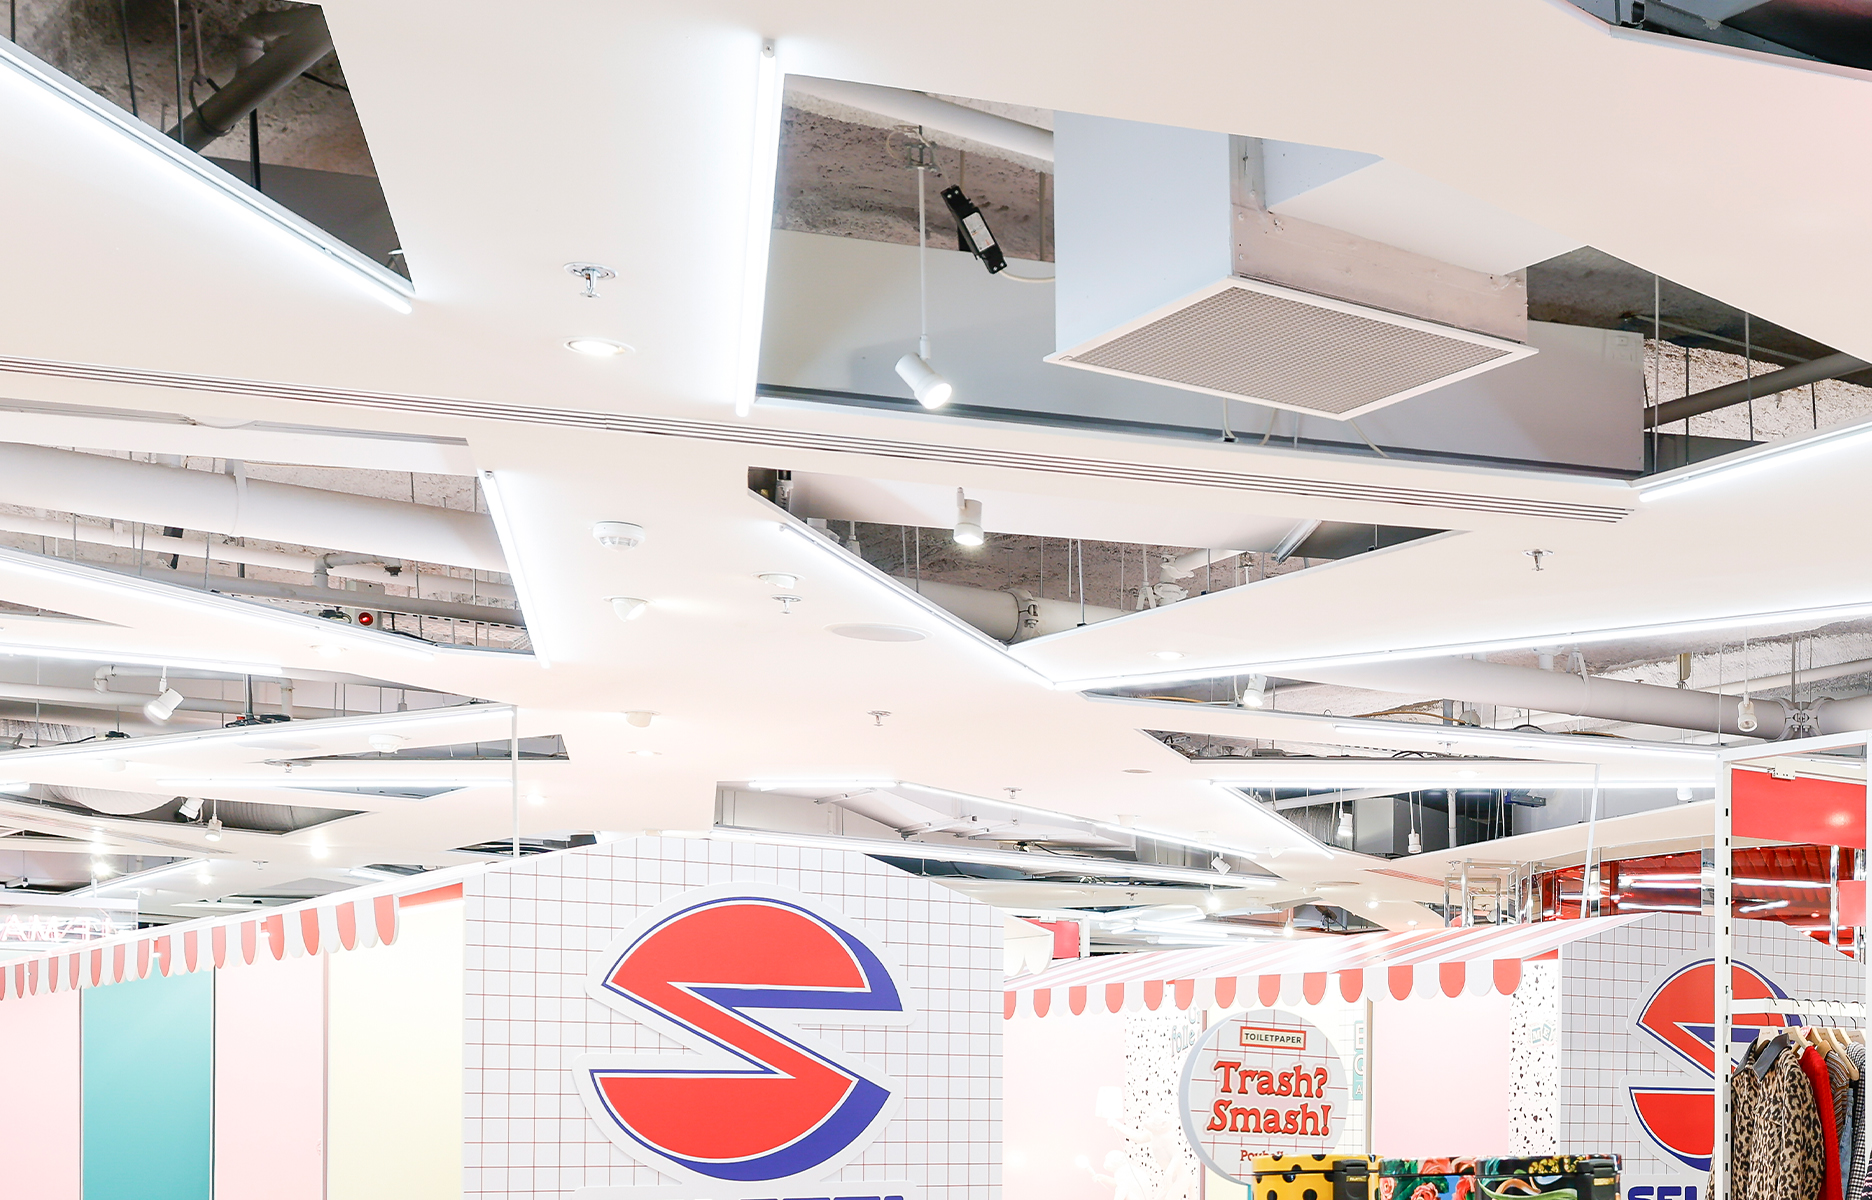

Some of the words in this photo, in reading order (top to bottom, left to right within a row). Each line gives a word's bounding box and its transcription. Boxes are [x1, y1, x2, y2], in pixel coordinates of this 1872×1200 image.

[1244, 1032, 1302, 1045] TOILETPAPER
[1213, 1060, 1328, 1098] Trash?
[1206, 1099, 1332, 1137] Smash!
